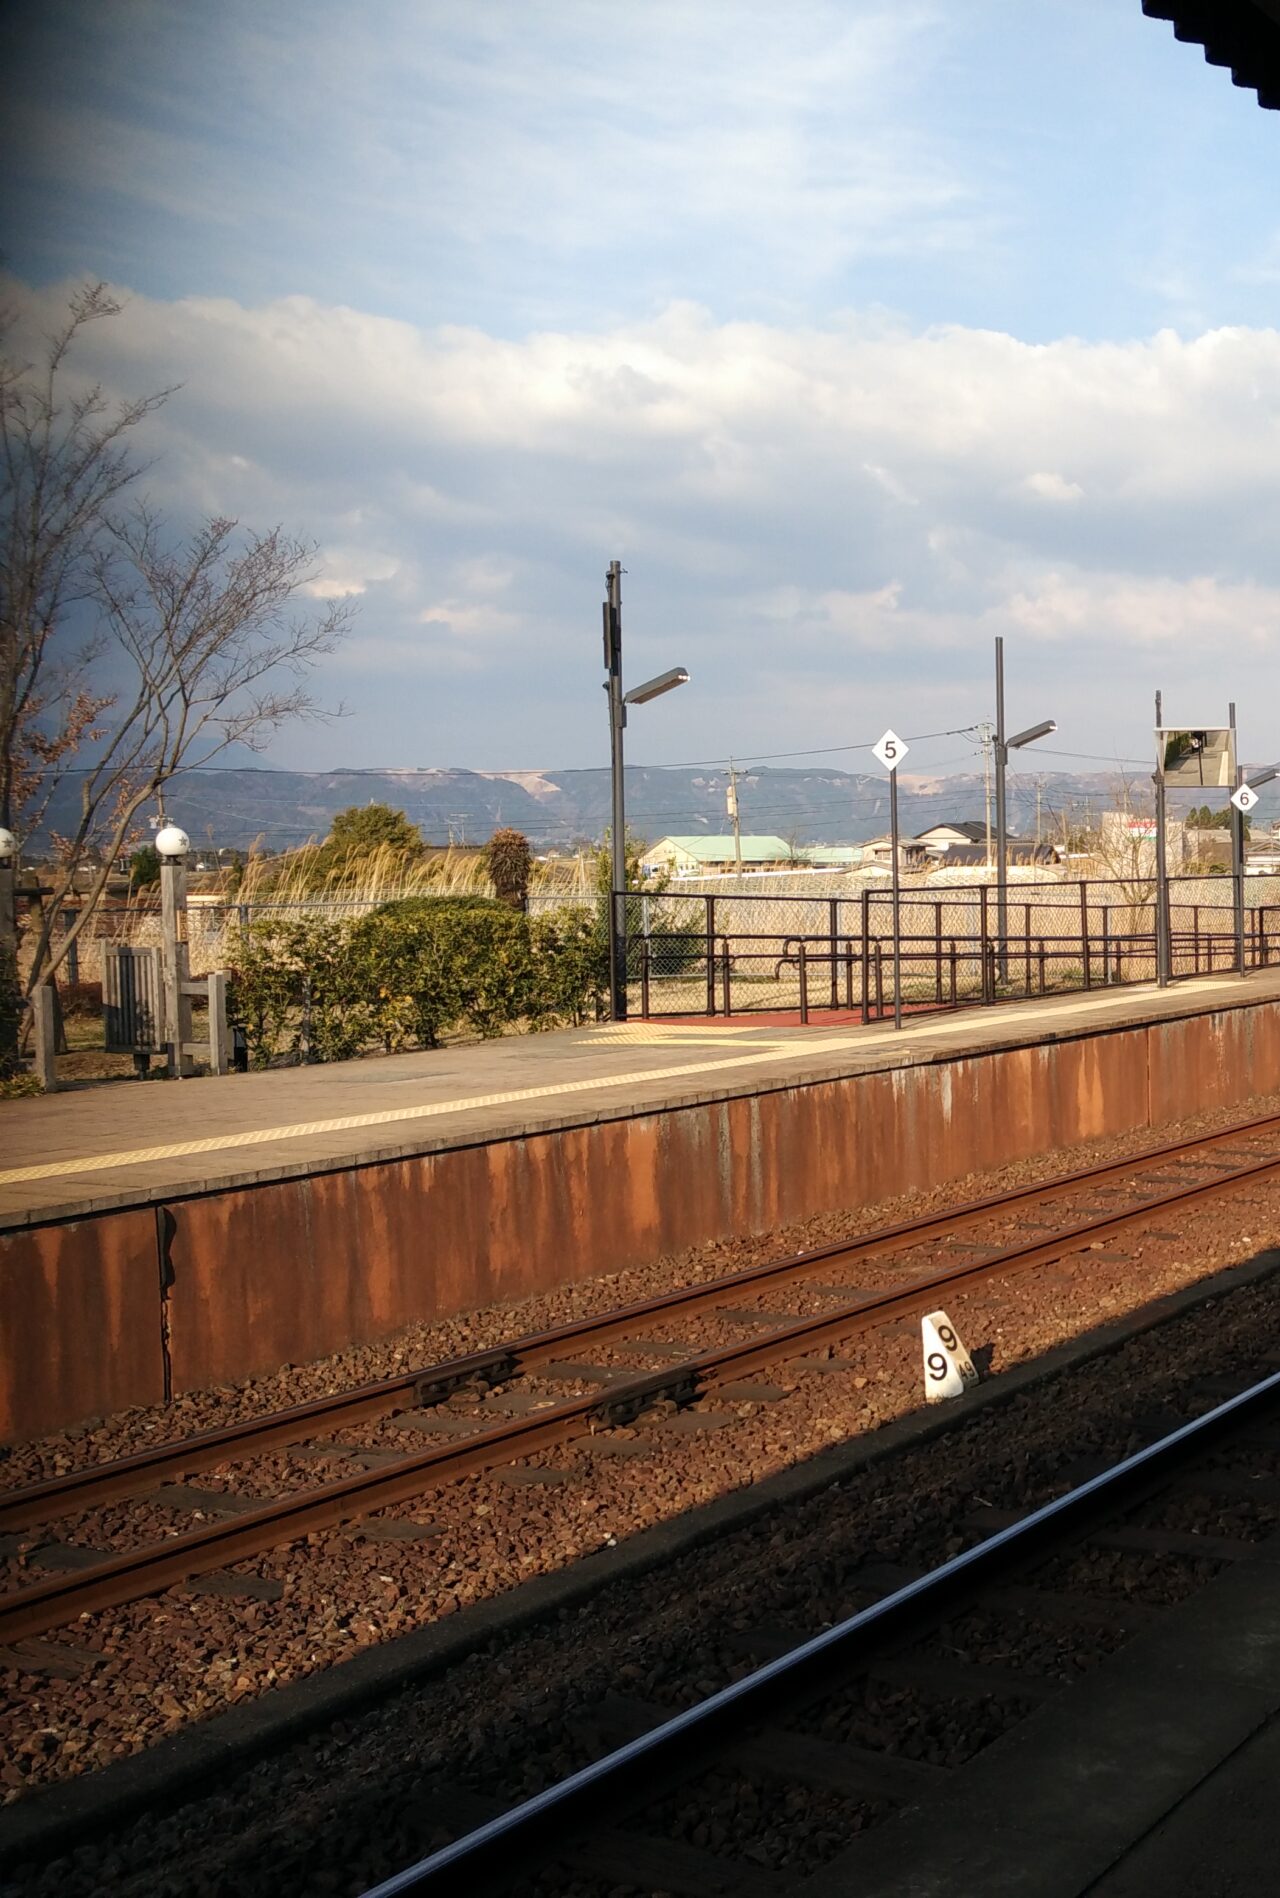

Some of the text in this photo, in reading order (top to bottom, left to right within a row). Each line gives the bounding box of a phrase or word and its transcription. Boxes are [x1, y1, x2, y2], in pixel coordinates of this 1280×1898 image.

[885, 741, 896, 759] 5
[1240, 792, 1250, 806] 6
[938, 1325, 957, 1351] 9
[928, 1353, 947, 1380] 9
